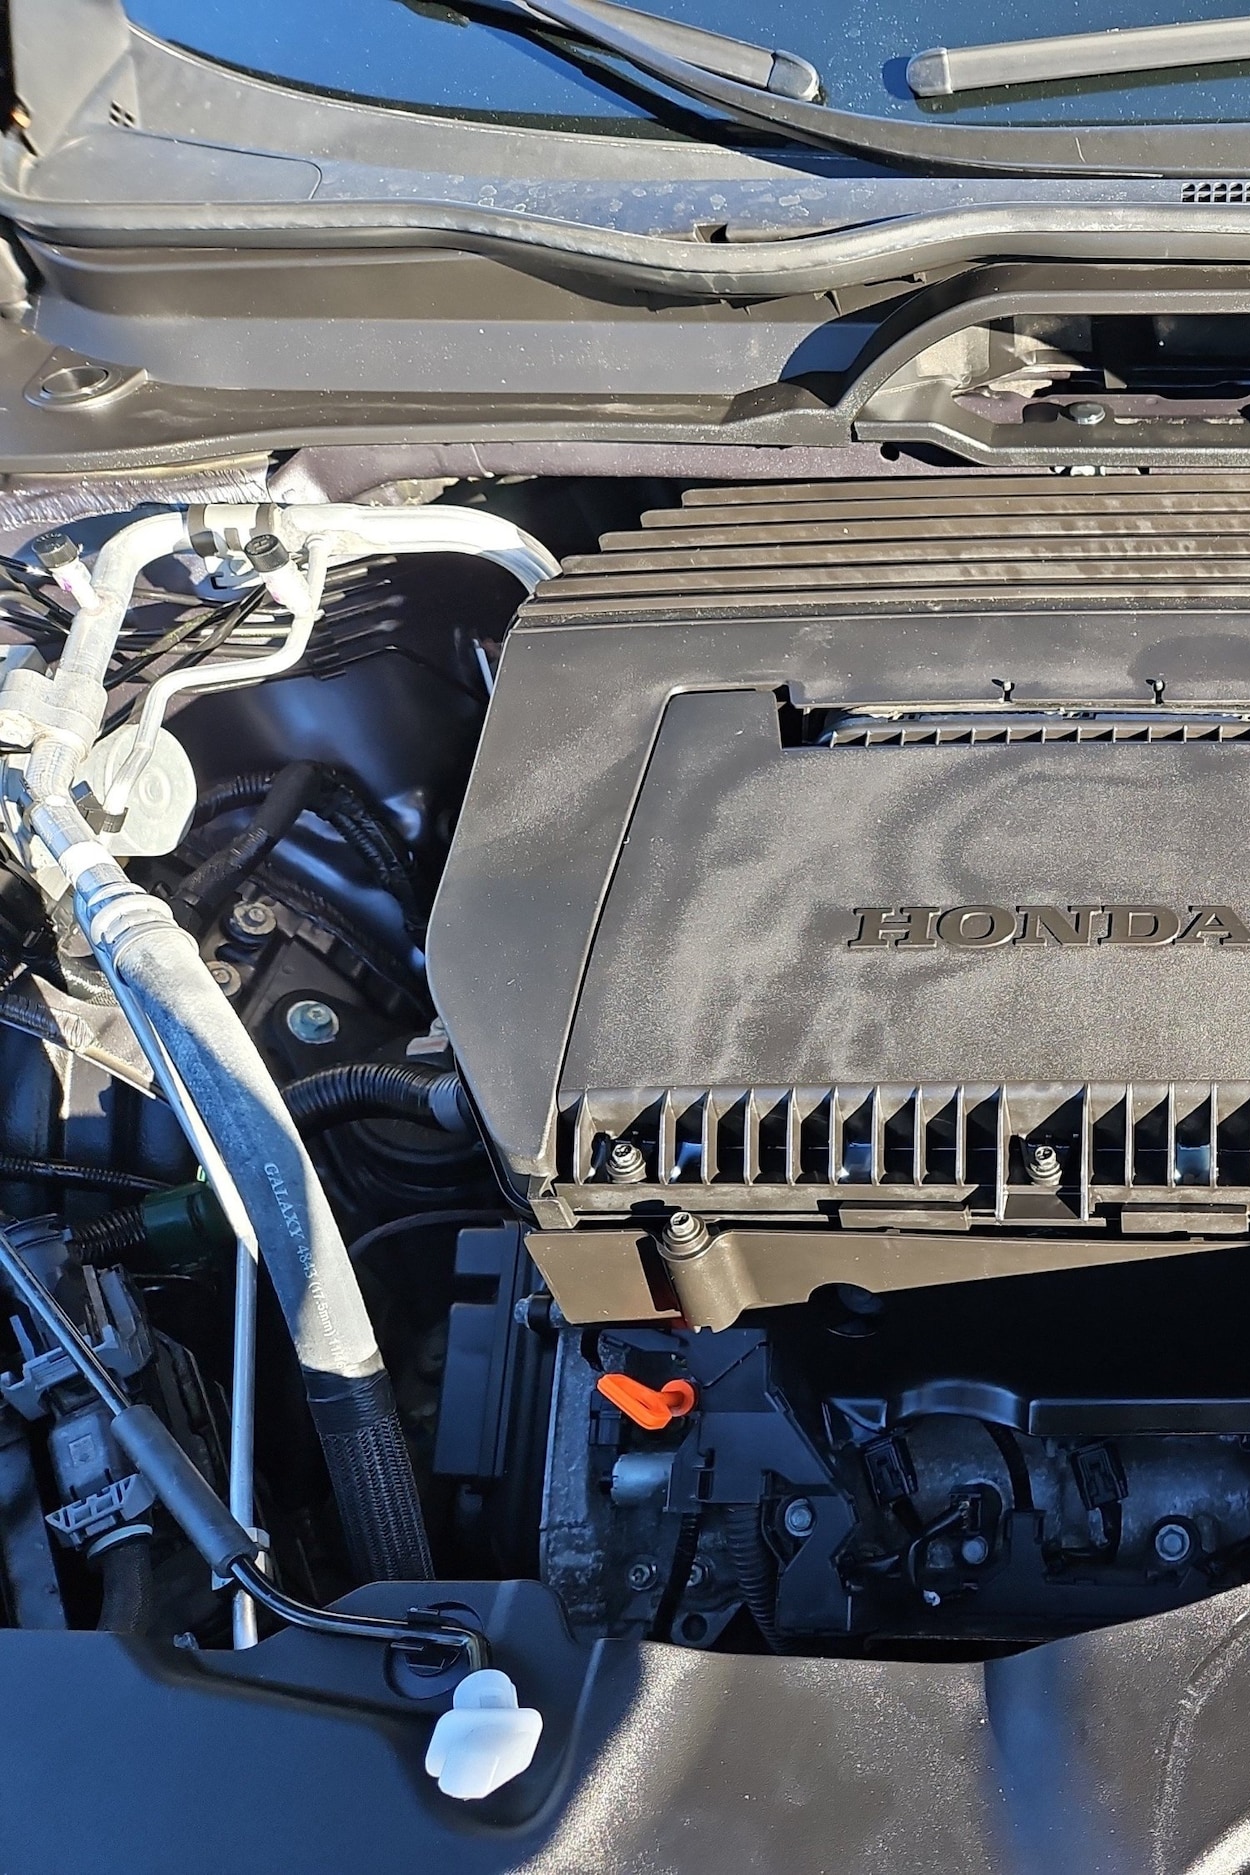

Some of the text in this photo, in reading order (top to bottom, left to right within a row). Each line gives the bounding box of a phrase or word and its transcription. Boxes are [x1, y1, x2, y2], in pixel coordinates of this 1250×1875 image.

[264, 1162, 305, 1239] GALAXY
[297, 1245, 317, 1279] 4843
[308, 1281, 337, 1337] (17.5mm)
